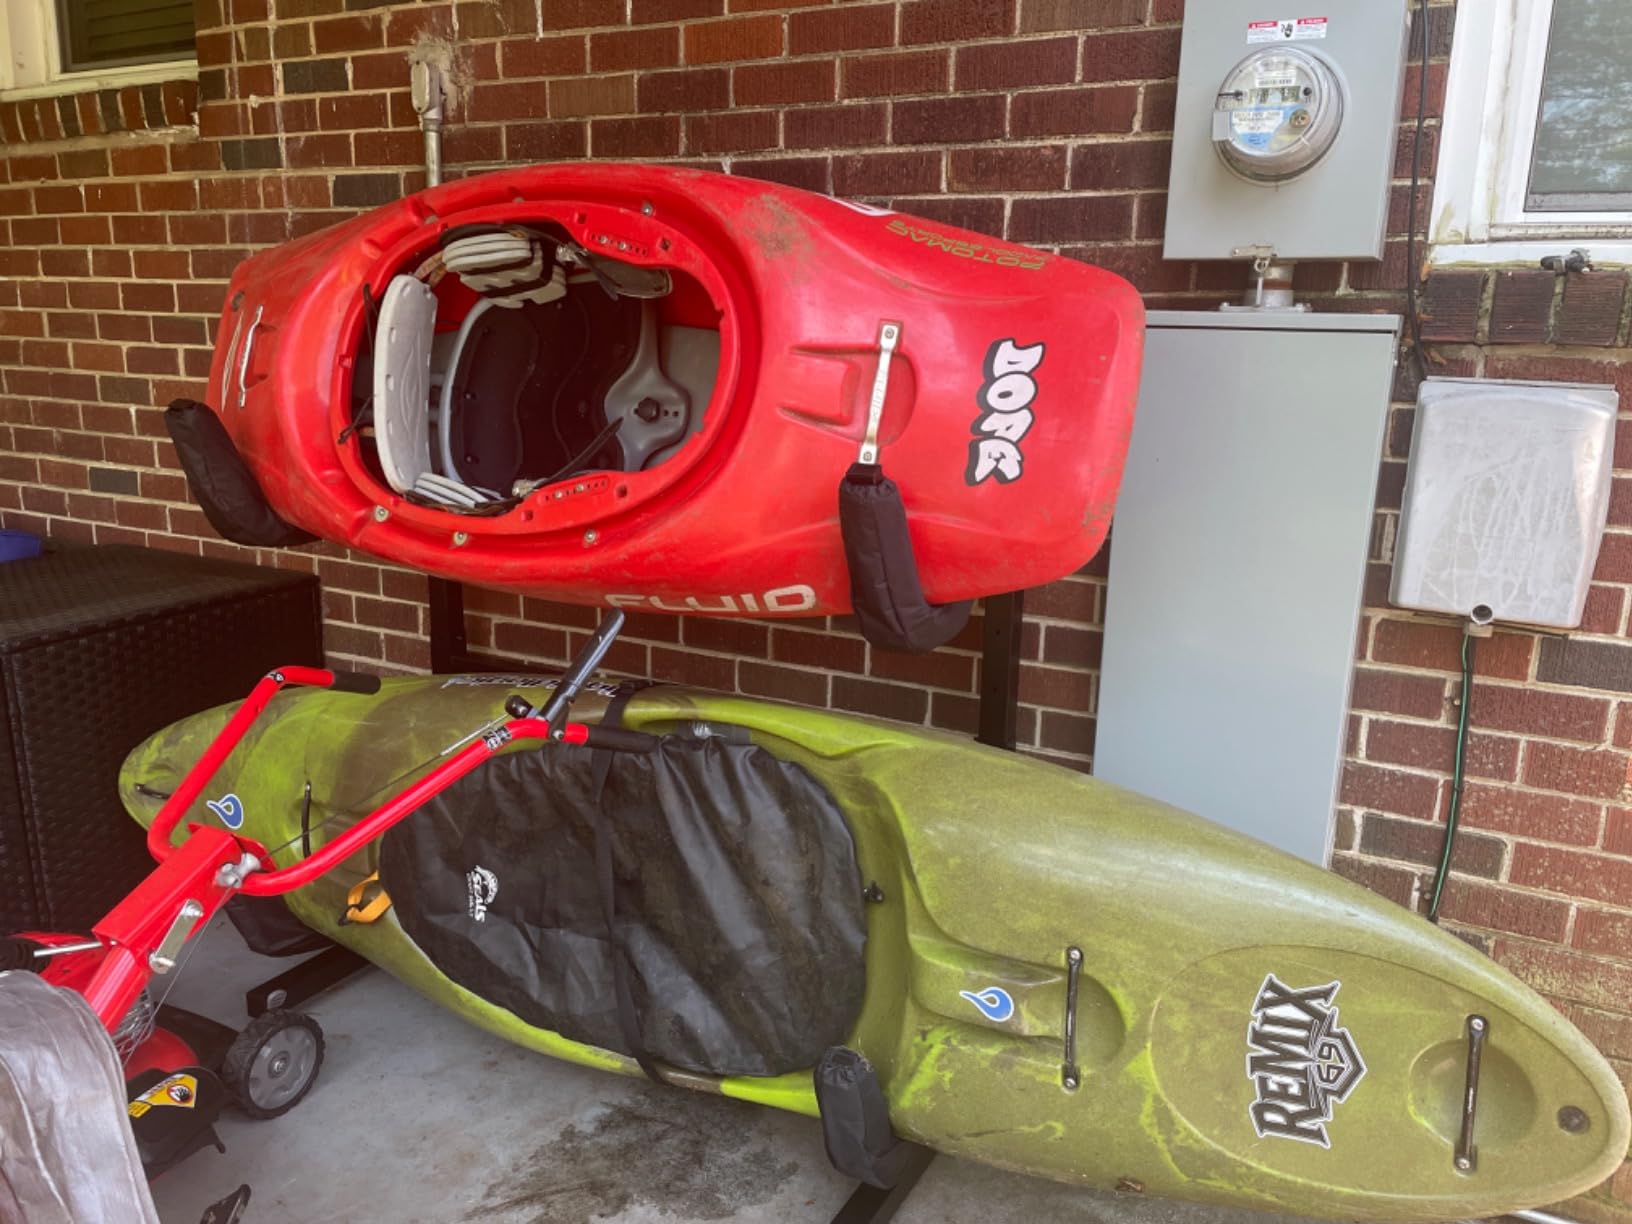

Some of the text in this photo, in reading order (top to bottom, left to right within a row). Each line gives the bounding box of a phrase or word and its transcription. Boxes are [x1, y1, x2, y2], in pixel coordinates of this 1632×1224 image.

[965, 338, 1046, 486] DOPE
[605, 584, 816, 612] FLUID
[1247, 973, 1341, 1149] REMIX
[1317, 1042, 1346, 1084] 69
